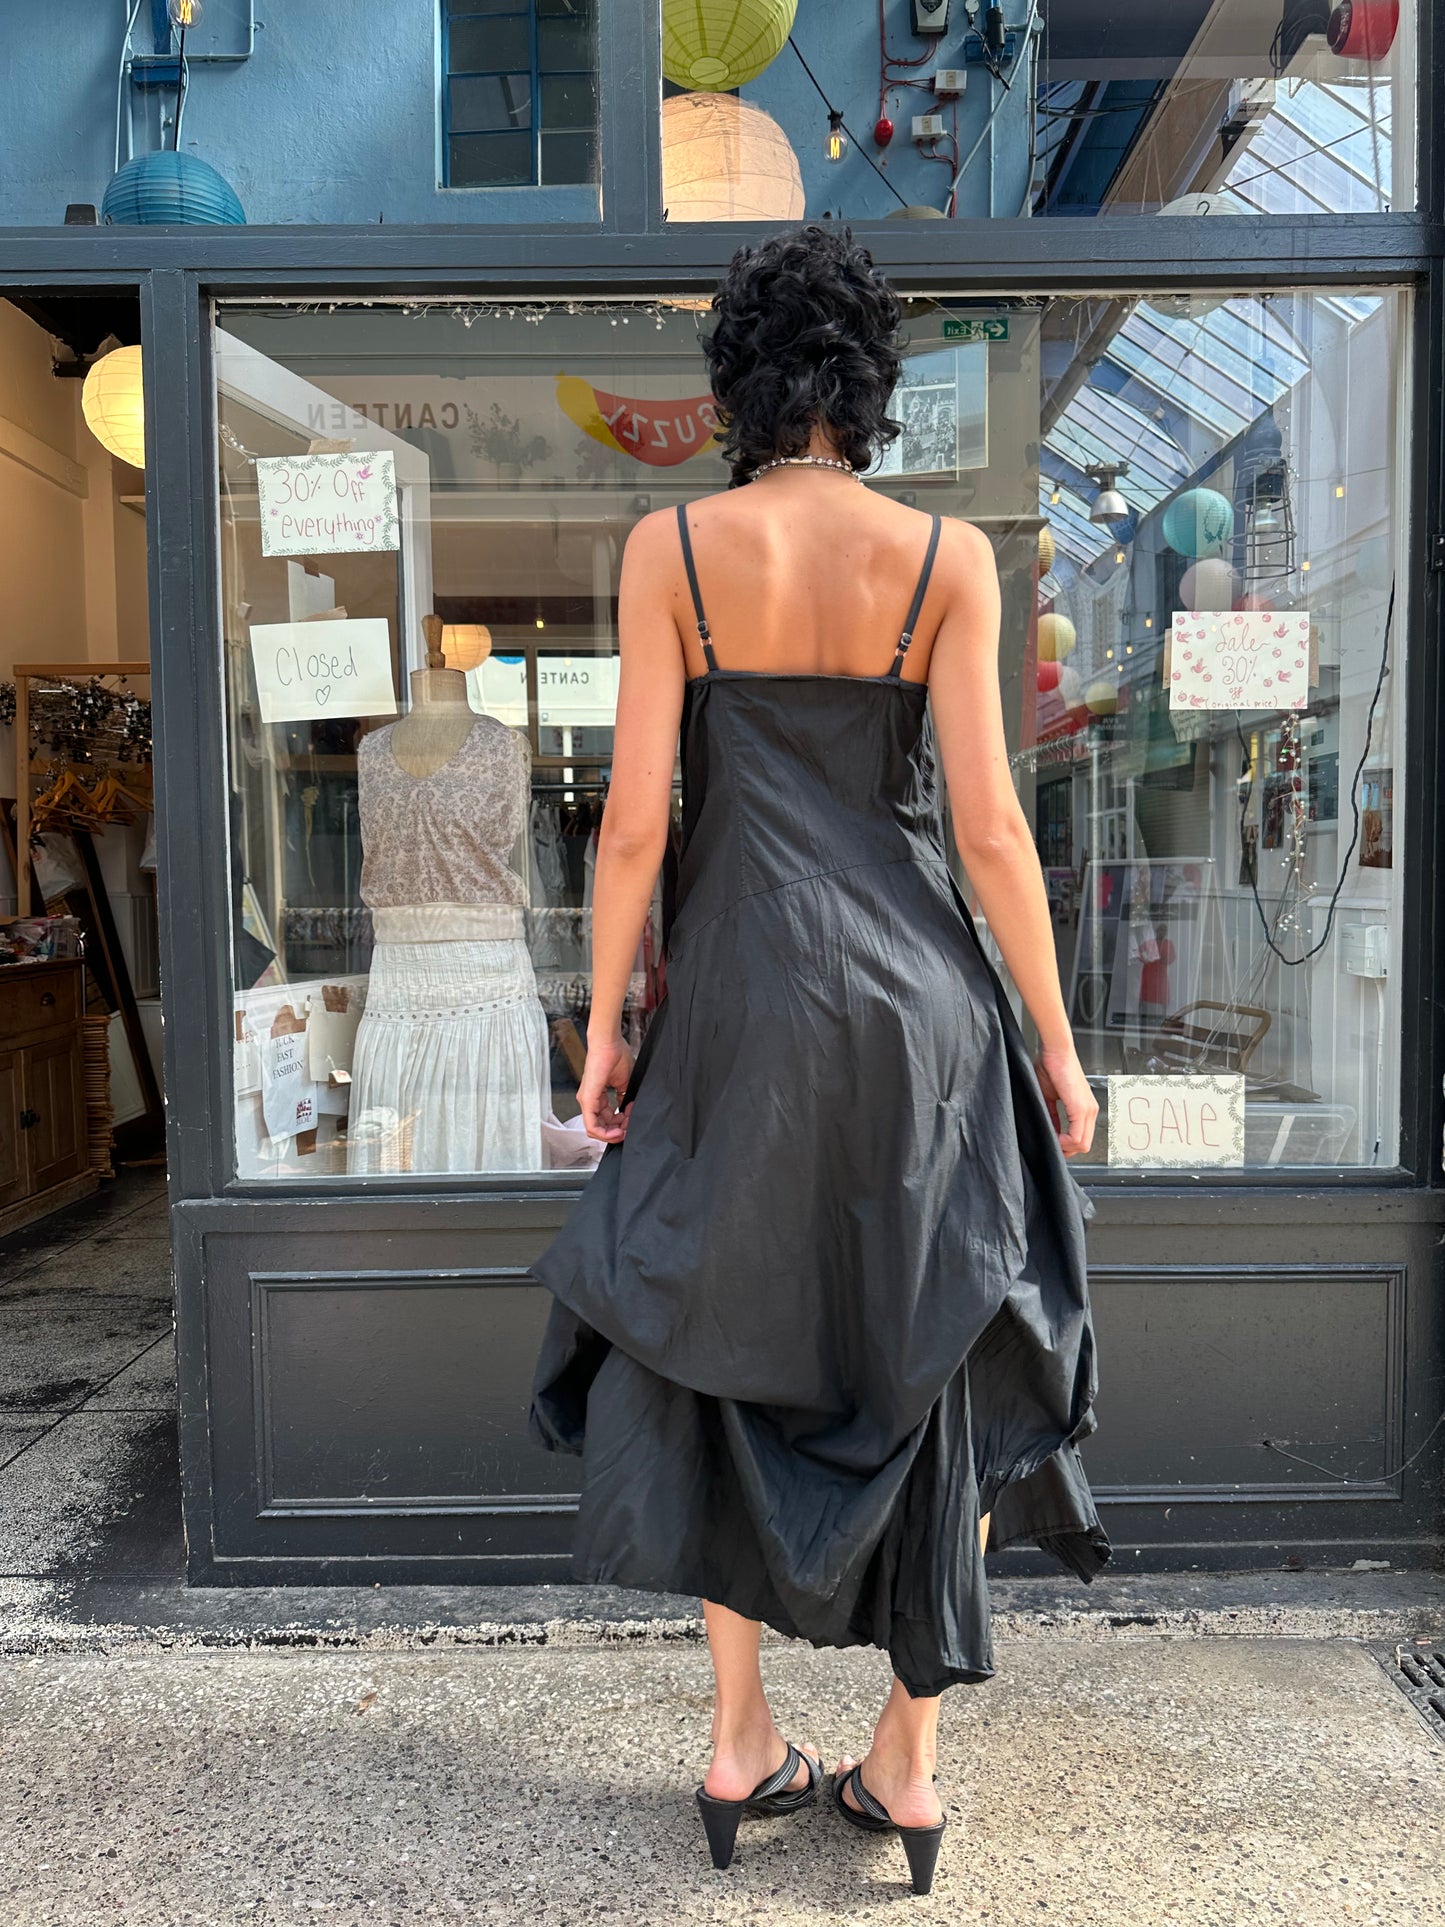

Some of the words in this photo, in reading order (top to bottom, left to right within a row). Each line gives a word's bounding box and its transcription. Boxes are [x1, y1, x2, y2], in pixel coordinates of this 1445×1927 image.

[272, 469, 322, 504] 30%
[333, 469, 366, 503] Off
[281, 512, 375, 545] everything
[1215, 621, 1270, 653] Sale
[276, 645, 358, 686] Closed
[1222, 655, 1258, 685] 30%
[1229, 686, 1243, 701] off
[272, 1060, 303, 1080] FASHION
[277, 1048, 294, 1063] FAST
